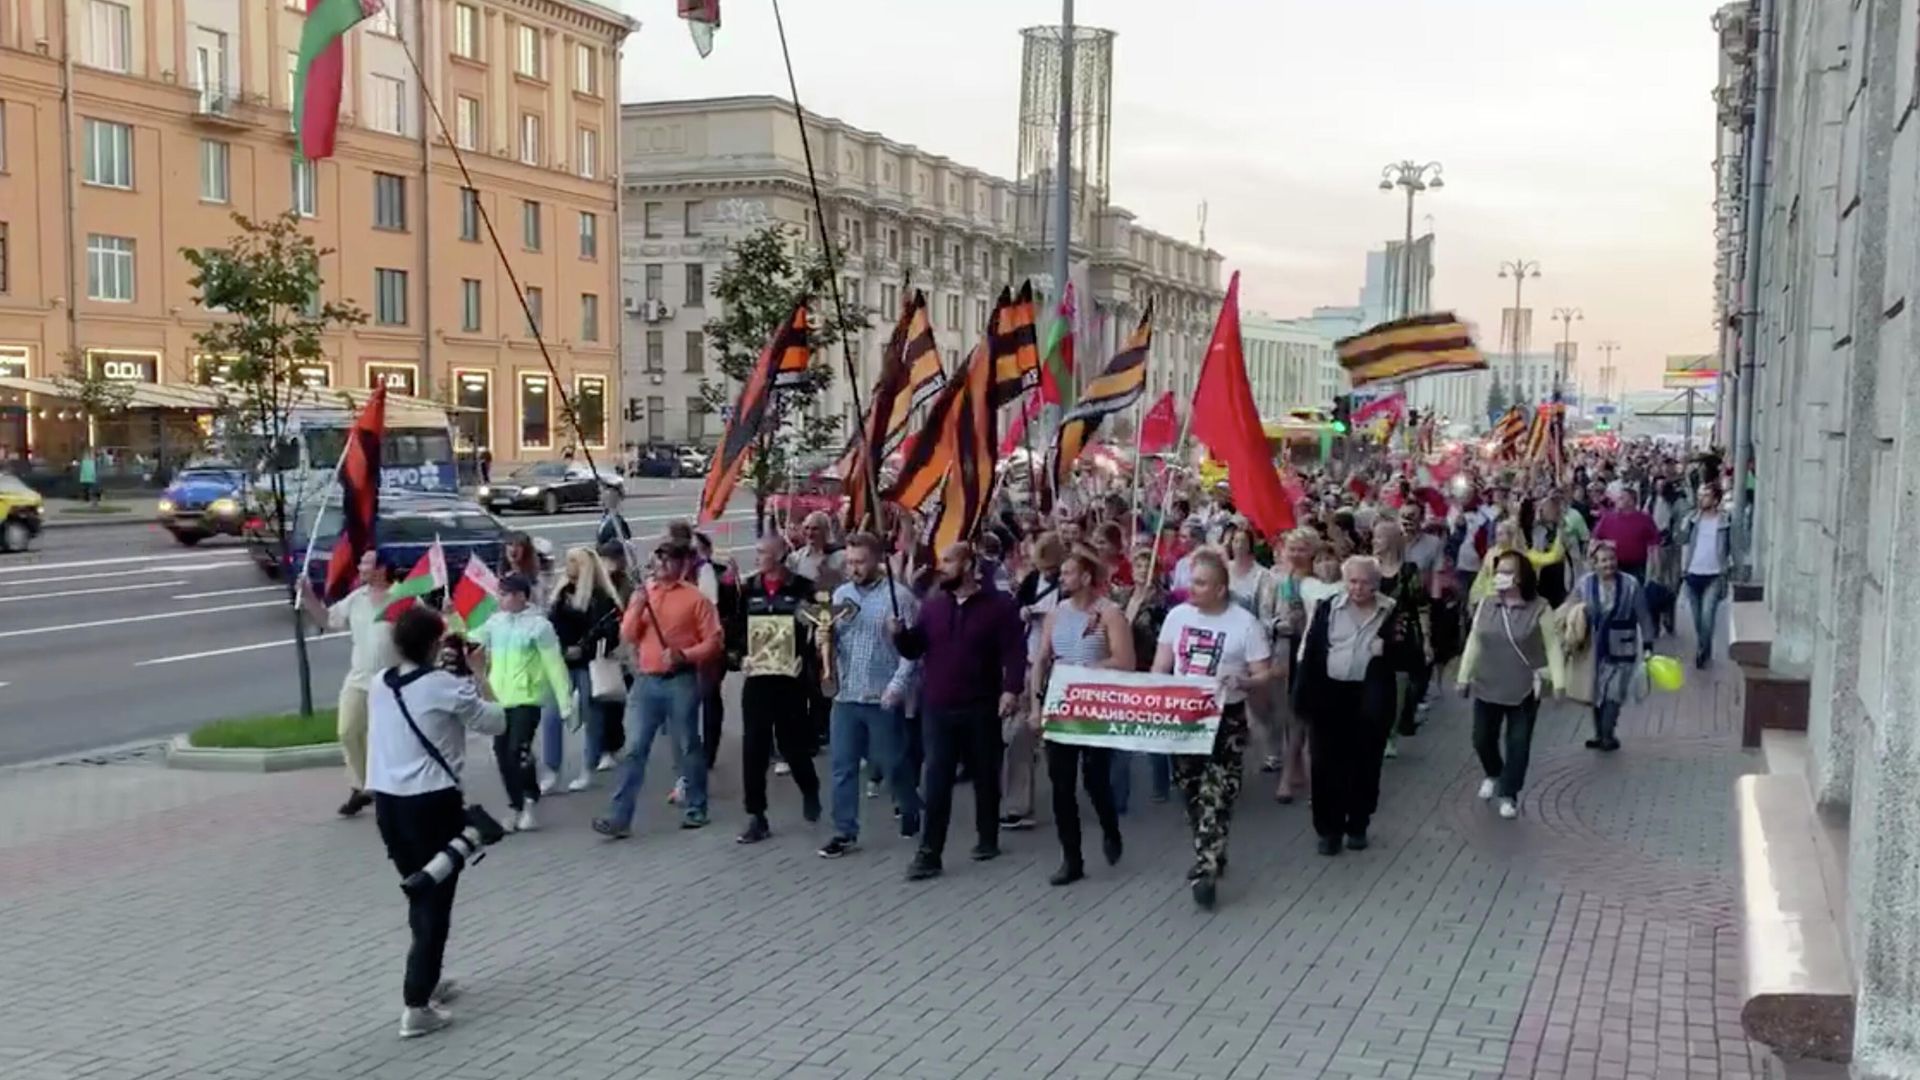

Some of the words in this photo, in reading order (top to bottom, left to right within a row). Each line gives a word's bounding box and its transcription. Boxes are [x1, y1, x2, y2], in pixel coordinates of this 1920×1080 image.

[1069, 688, 1142, 706] ОТЕЧЕСТВО
[1144, 694, 1162, 708] ОТ
[1165, 696, 1216, 711] БРЕСТА
[1073, 704, 1181, 725] ВЛАДИВОСТОКА
